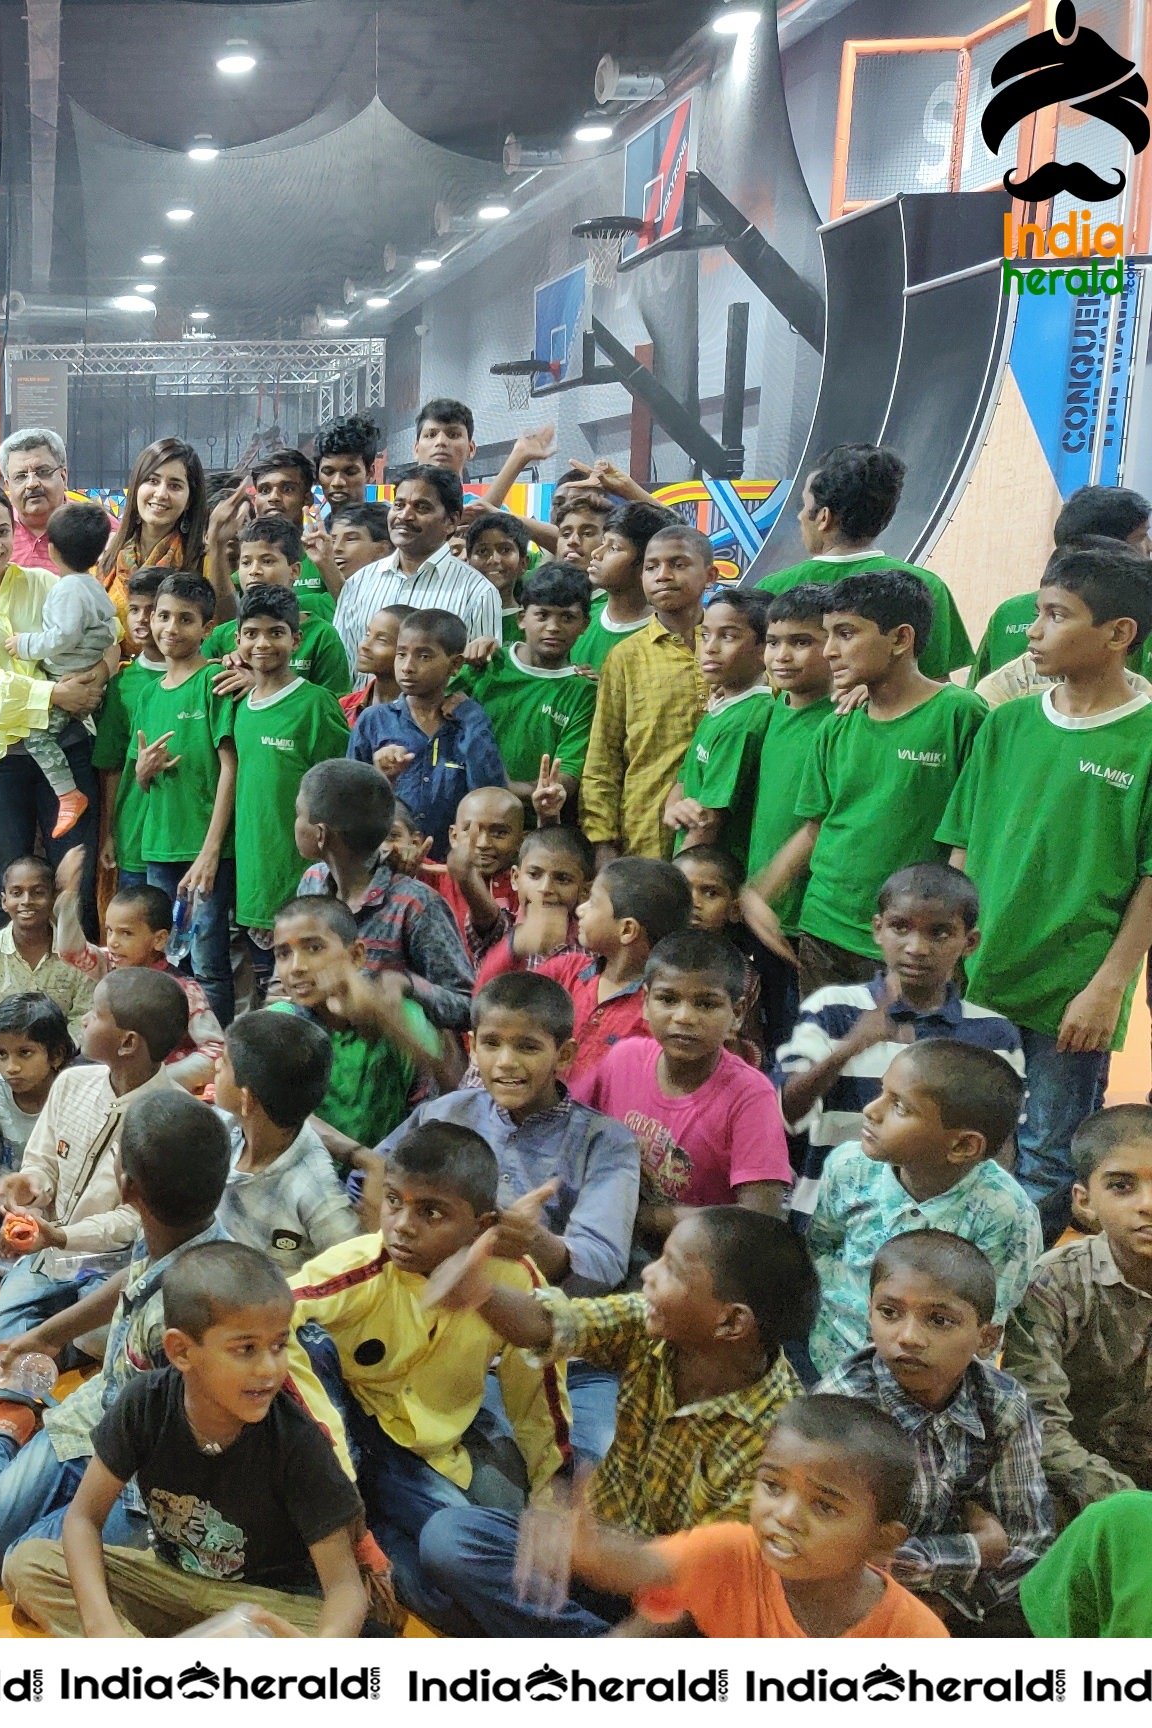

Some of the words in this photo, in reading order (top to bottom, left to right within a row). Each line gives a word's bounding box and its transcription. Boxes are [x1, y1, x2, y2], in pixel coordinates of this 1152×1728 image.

[261, 736, 295, 748] VALMIKI
[897, 748, 947, 763] VALMIKI
[1079, 759, 1135, 786] VALMIKI
